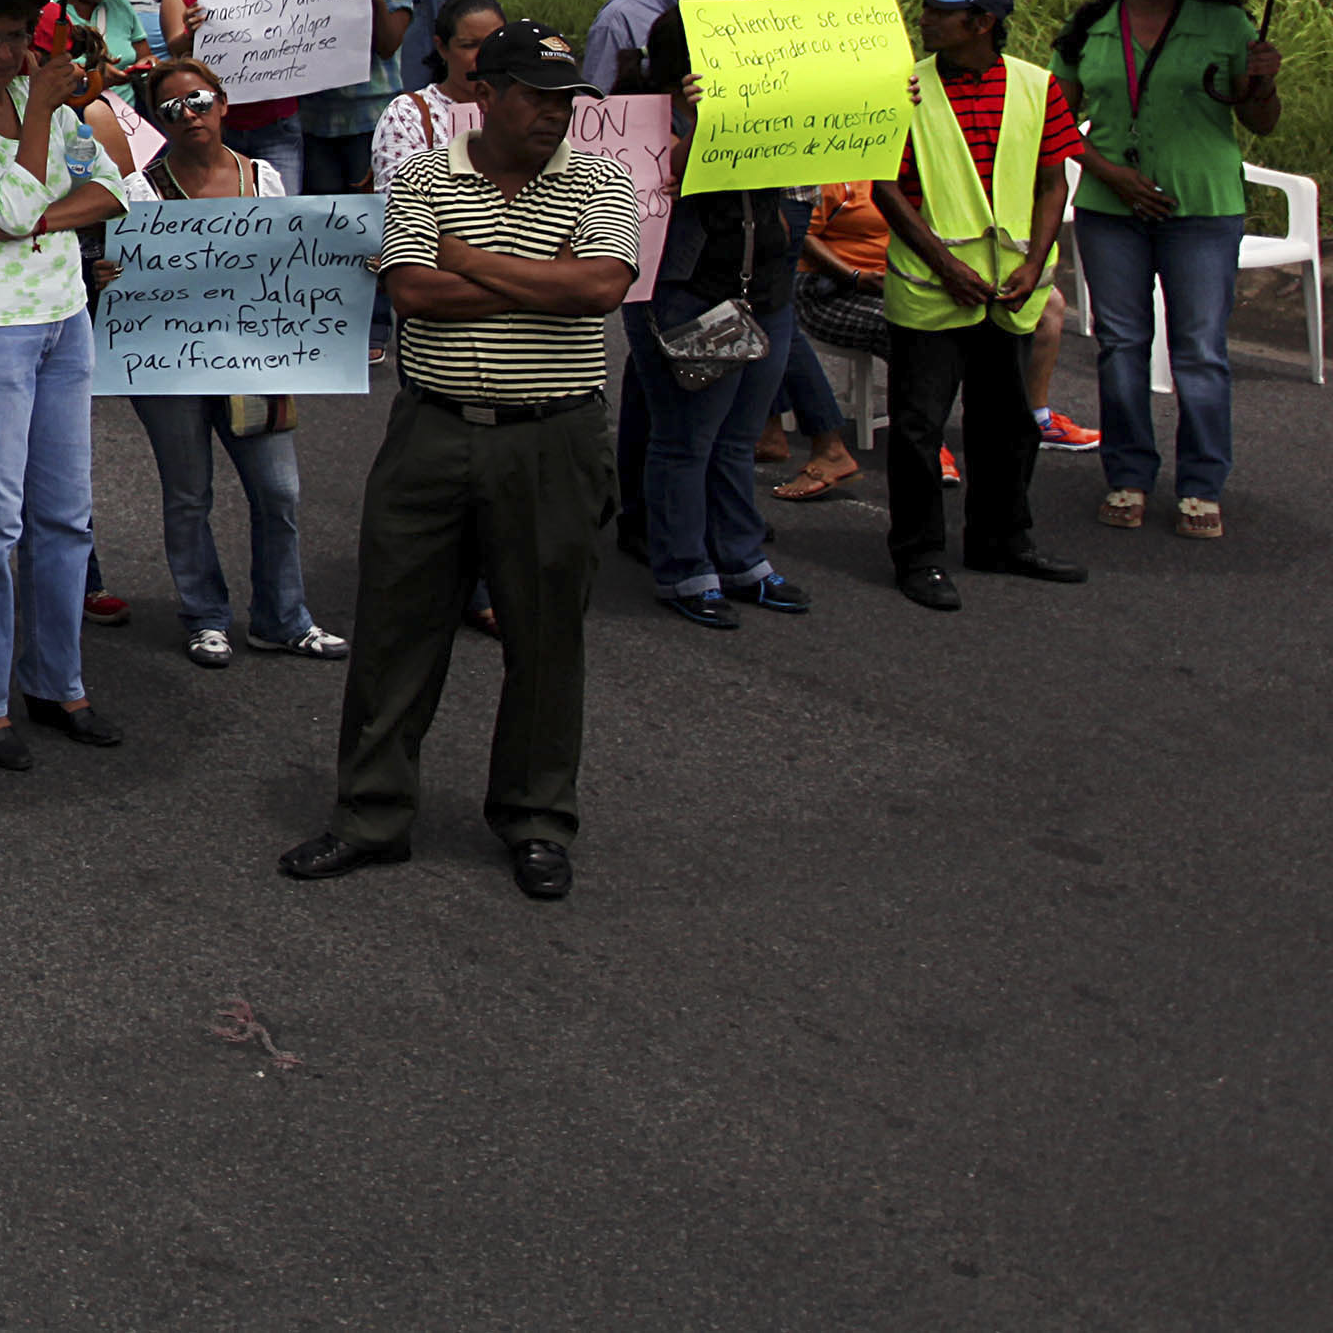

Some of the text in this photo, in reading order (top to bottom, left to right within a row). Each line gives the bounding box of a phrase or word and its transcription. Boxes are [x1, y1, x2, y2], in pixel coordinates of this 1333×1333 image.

[200, 13, 331, 50] presos en Xalapa
[696, 7, 803, 47] Septiembre
[818, 11, 839, 28] se
[202, 36, 337, 66] por manifestarse
[700, 47, 721, 70] la
[707, 70, 789, 108] de quién?
[804, 116, 815, 129] a
[823, 101, 897, 129] nuestros
[644, 146, 667, 184] Y
[803, 137, 821, 156] de
[114, 201, 368, 237] Liberación a los
[118, 238, 366, 277] Maestros y Alumn
[105, 273, 343, 315] presos en Jalapa
[106, 305, 348, 349] por manifestarse
